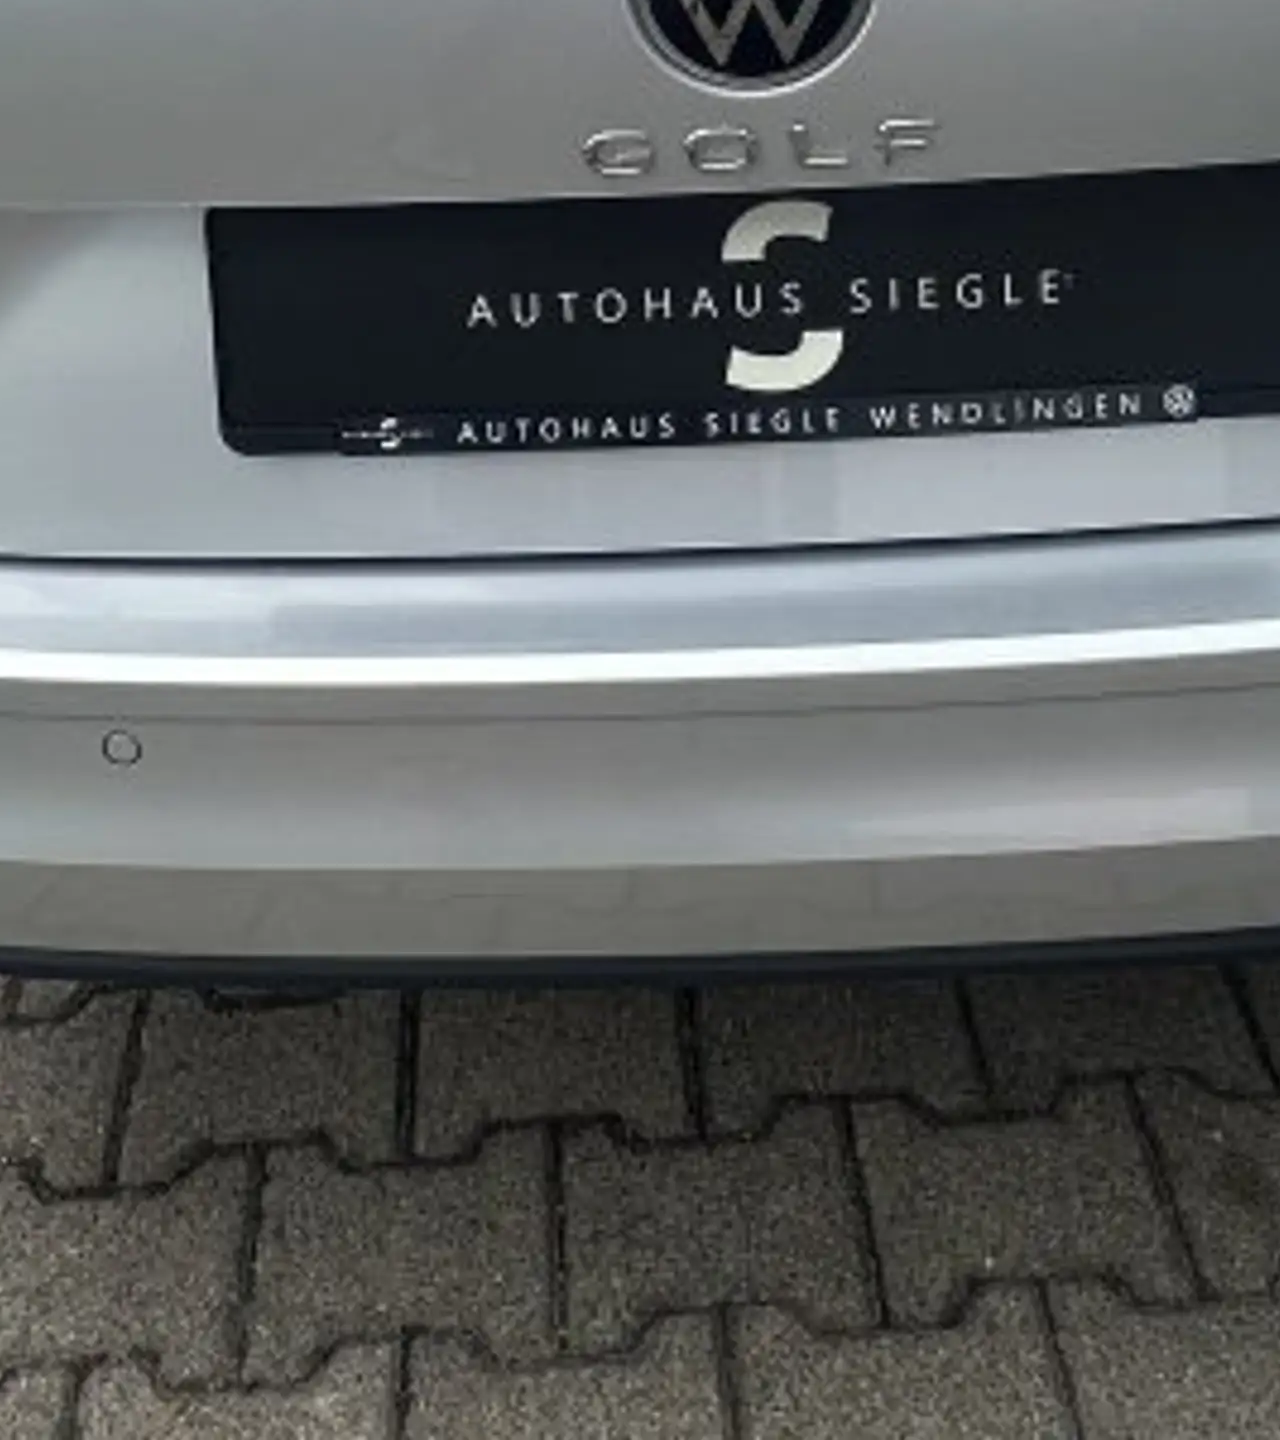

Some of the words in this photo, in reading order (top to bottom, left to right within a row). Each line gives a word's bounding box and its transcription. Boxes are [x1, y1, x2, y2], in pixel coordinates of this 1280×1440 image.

[583, 119, 935, 175] GOLF
[467, 281, 804, 328] AUTOHAUS
[849, 269, 1062, 314] SIEGLE
[456, 413, 675, 443] AUTOHAUS
[704, 407, 840, 435] SIEGLE
[869, 393, 1142, 430] WENDLINGEN
